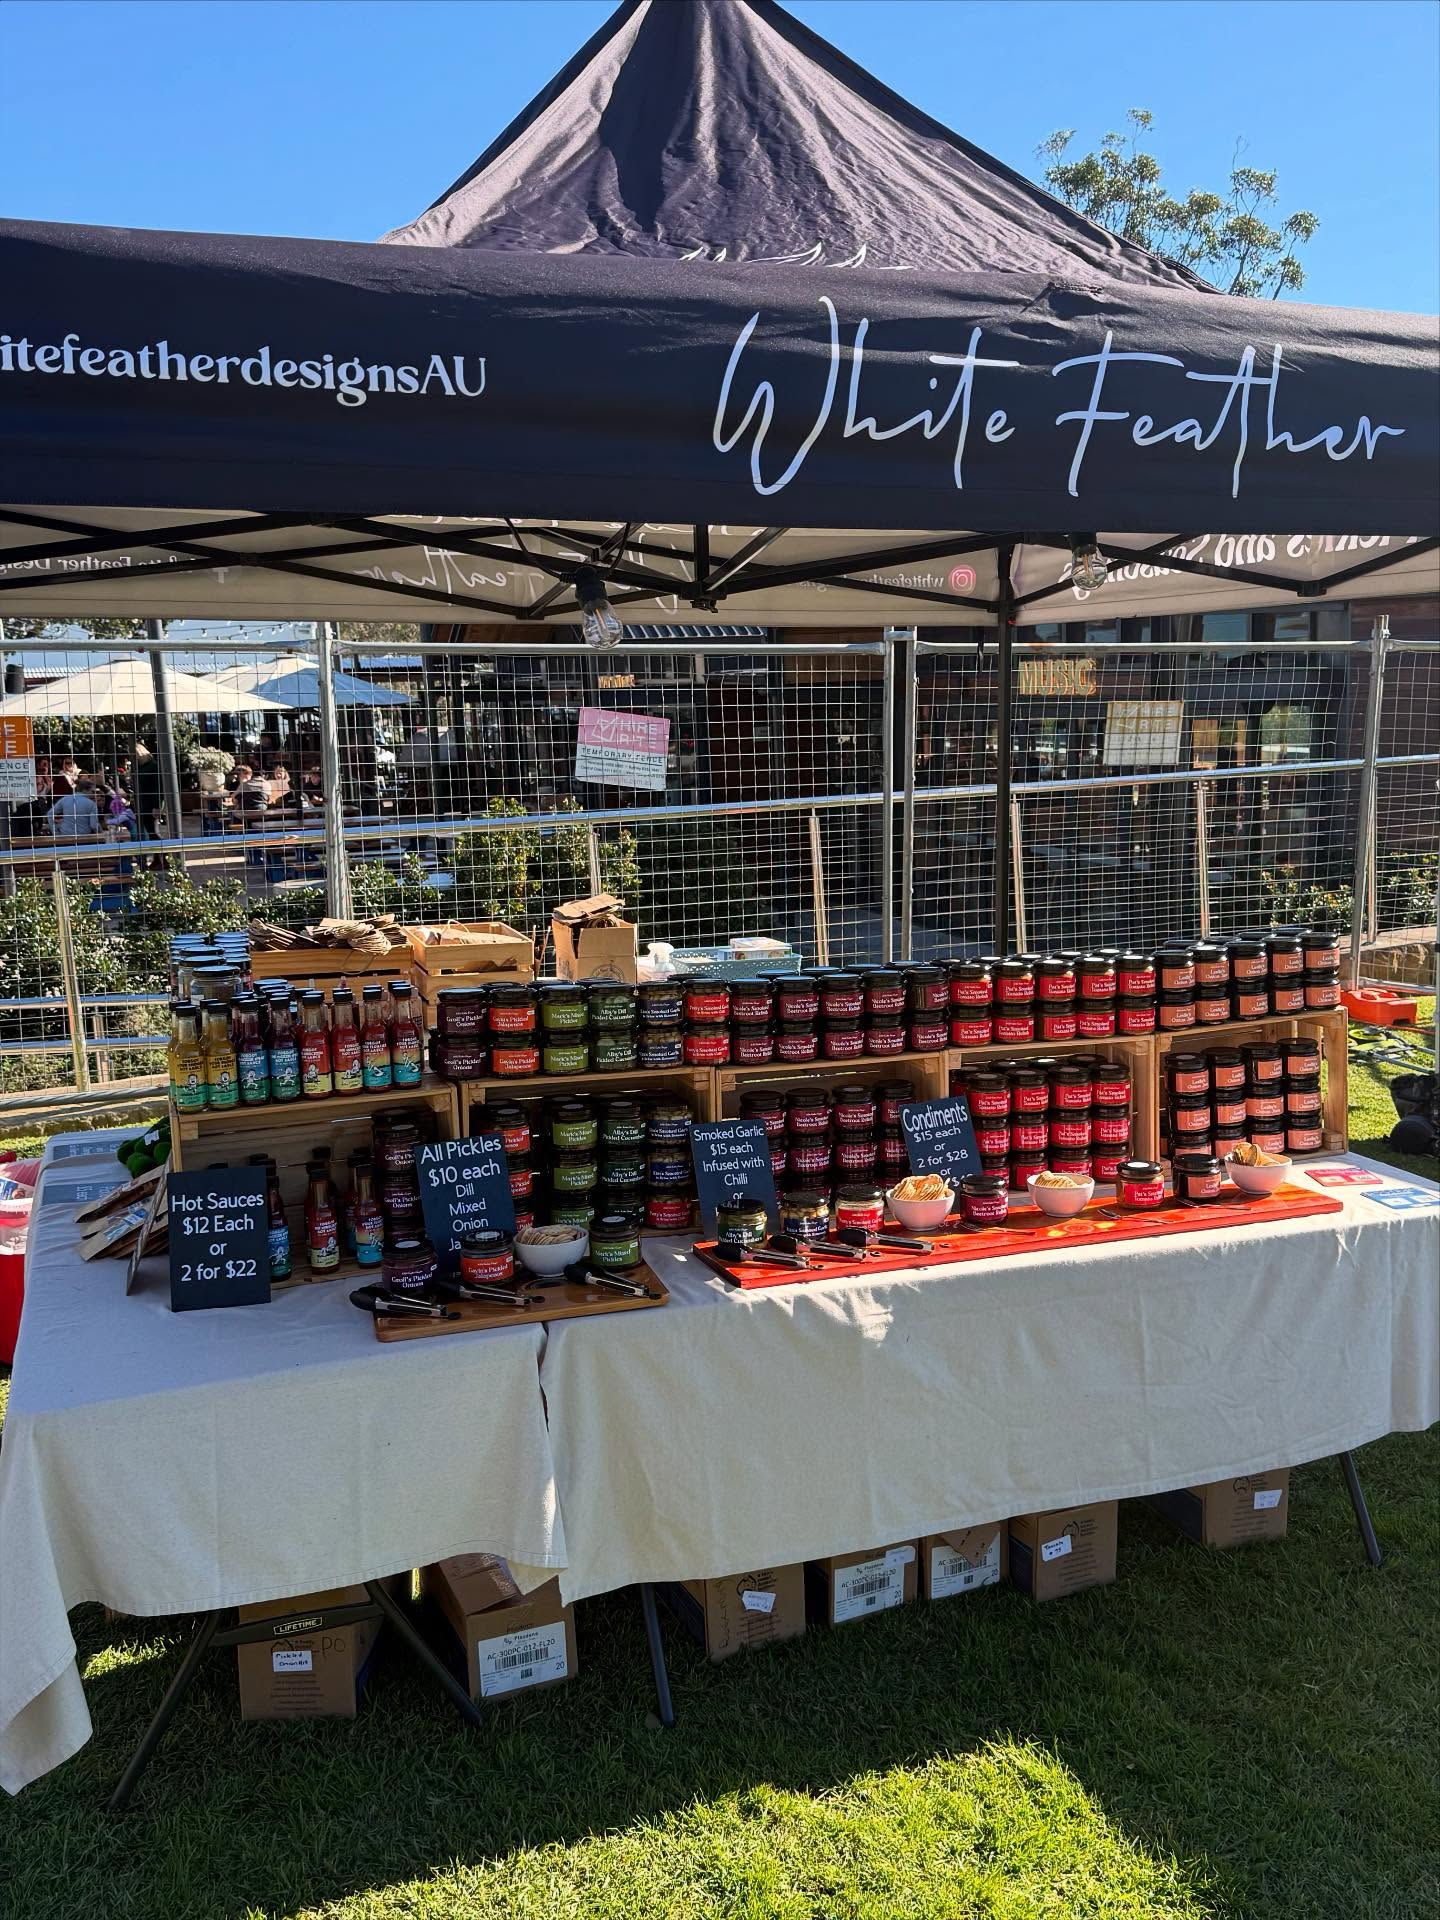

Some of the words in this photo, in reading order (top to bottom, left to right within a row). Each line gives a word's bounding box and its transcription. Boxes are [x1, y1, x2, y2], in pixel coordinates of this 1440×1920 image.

[713, 296, 1019, 495] White
[1051, 329, 1406, 498] Feather
[1019, 659, 1096, 695] MUSIC
[620, 719, 657, 735] HIRE
[902, 1102, 968, 1132] Condiments
[693, 1126, 734, 1141] Smoked
[735, 1125, 764, 1138] Garlic
[913, 1130, 933, 1143] $15
[935, 1126, 961, 1138] each
[420, 1143, 444, 1164] All
[445, 1137, 502, 1160] Pickles
[710, 1143, 728, 1156] $15
[729, 1141, 754, 1154] each
[934, 1142, 946, 1151] or
[702, 1158, 740, 1172] Infused
[740, 1156, 765, 1168] with
[917, 1158, 926, 1168] 2
[927, 1156, 944, 1166] for
[946, 1149, 969, 1162] $28
[428, 1166, 458, 1188] $10
[462, 1159, 501, 1180] each
[724, 1173, 748, 1185] Chilli
[940, 1167, 952, 1176] or
[455, 1182, 475, 1198] Dill
[732, 1192, 744, 1200] or
[171, 1194, 203, 1213] Hot
[207, 1192, 264, 1210] Sauces
[449, 1198, 487, 1217] Mixed
[182, 1216, 210, 1236] $12
[214, 1214, 254, 1232] Each
[452, 1217, 489, 1232] Onion
[209, 1242, 227, 1256] or
[448, 1237, 461, 1251] Ja
[181, 1264, 192, 1282] 2
[196, 1264, 220, 1280] for
[225, 1259, 257, 1279] $22
[412, 1272, 432, 1281] Pickled
[279, 1620, 317, 1633] LIFETIME
[555, 1661, 565, 1671] 20
